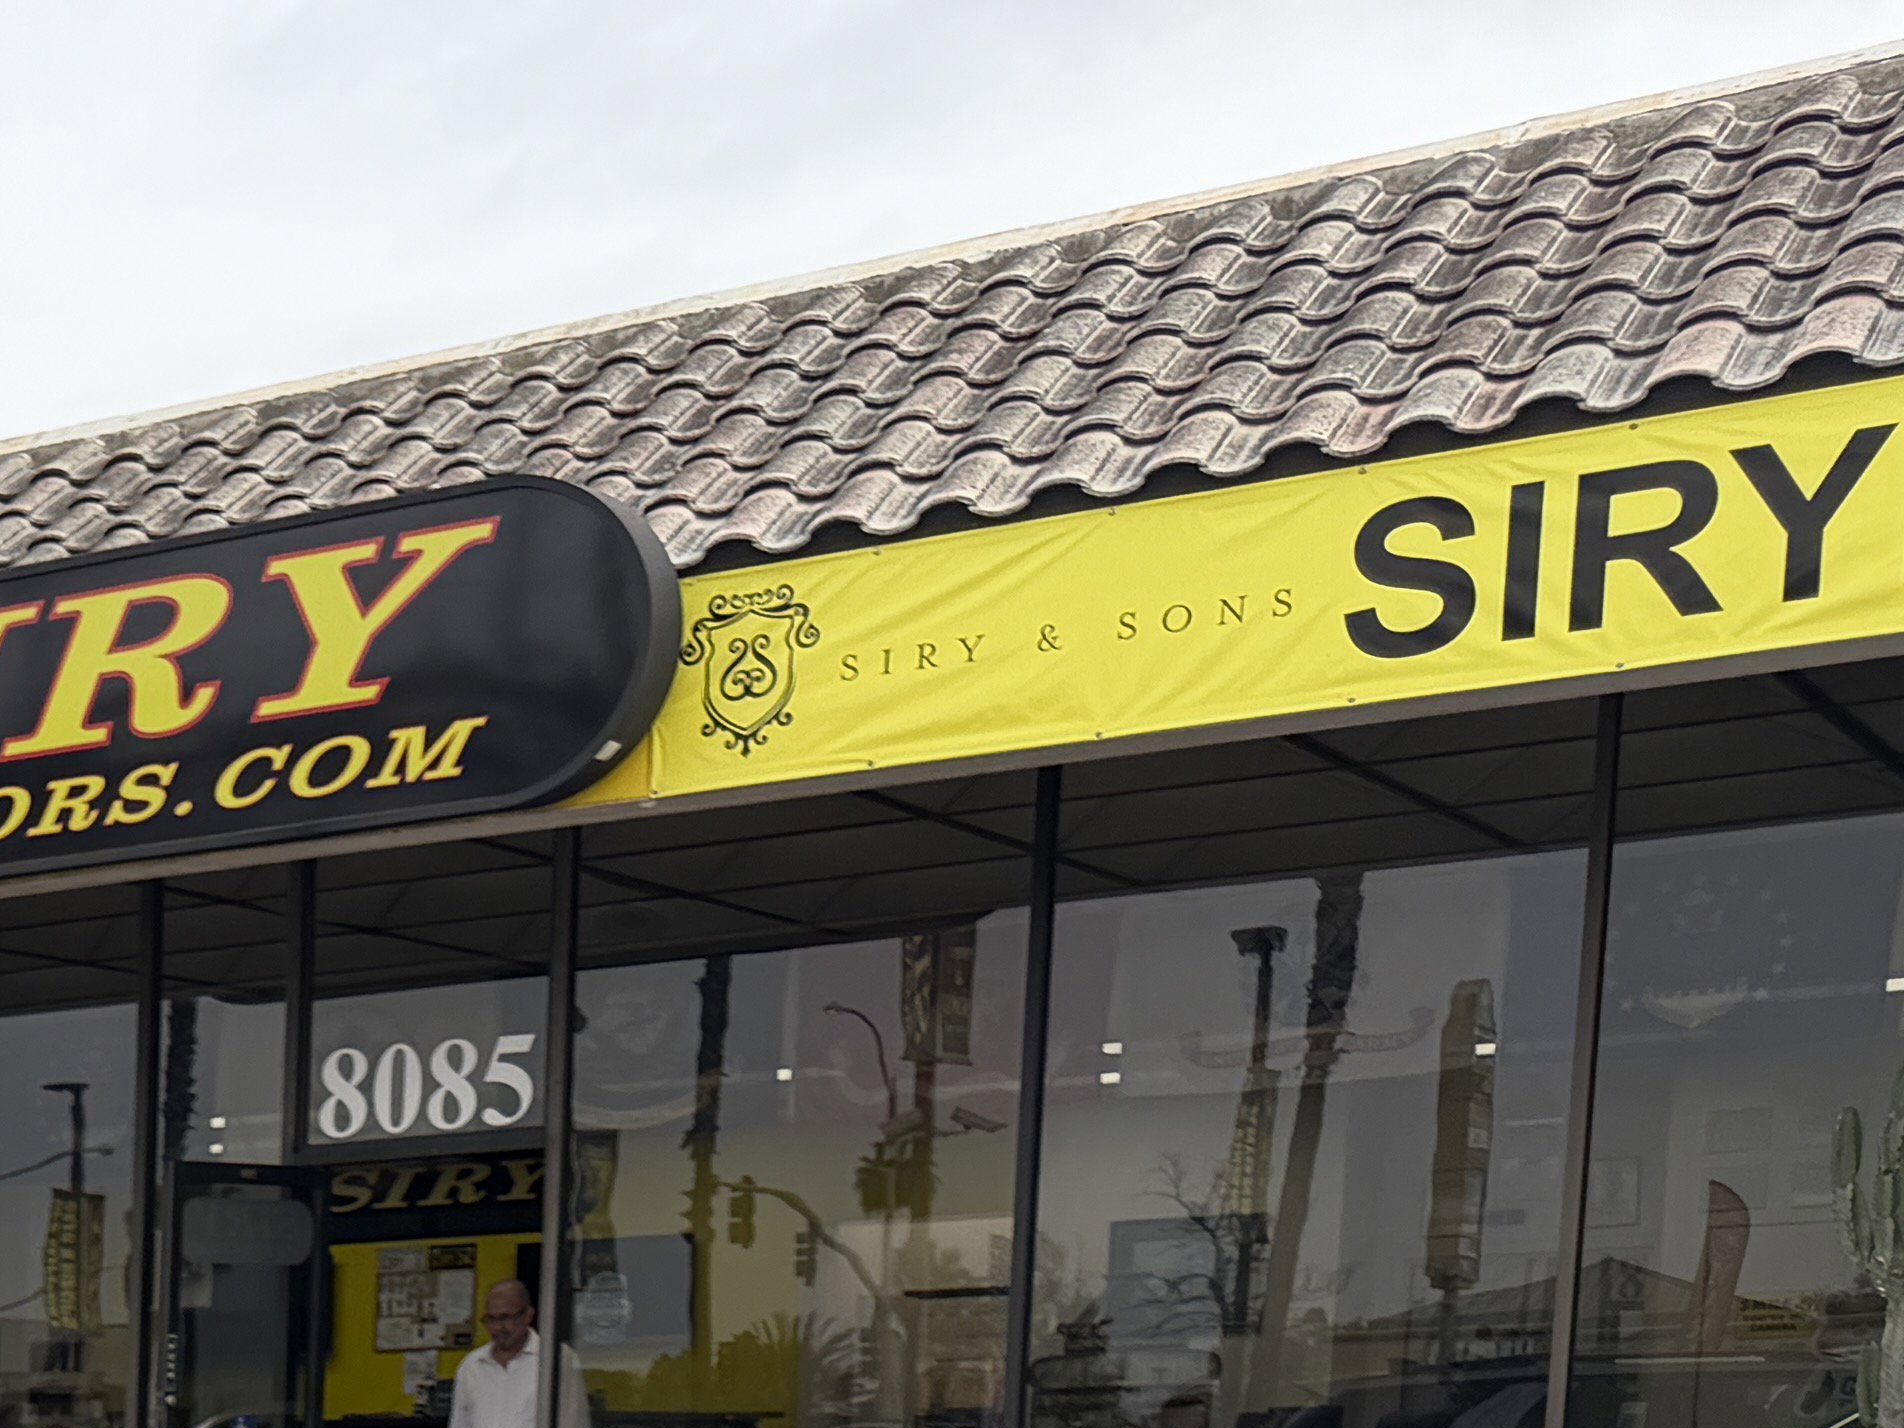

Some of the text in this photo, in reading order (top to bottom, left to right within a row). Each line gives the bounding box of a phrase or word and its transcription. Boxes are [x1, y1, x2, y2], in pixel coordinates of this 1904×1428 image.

[1344, 422, 1900, 659] SIRY
[840, 588, 1293, 681] SIRY & SONS
[318, 1034, 535, 1138] 8085
[329, 1157, 543, 1213] SIRY
